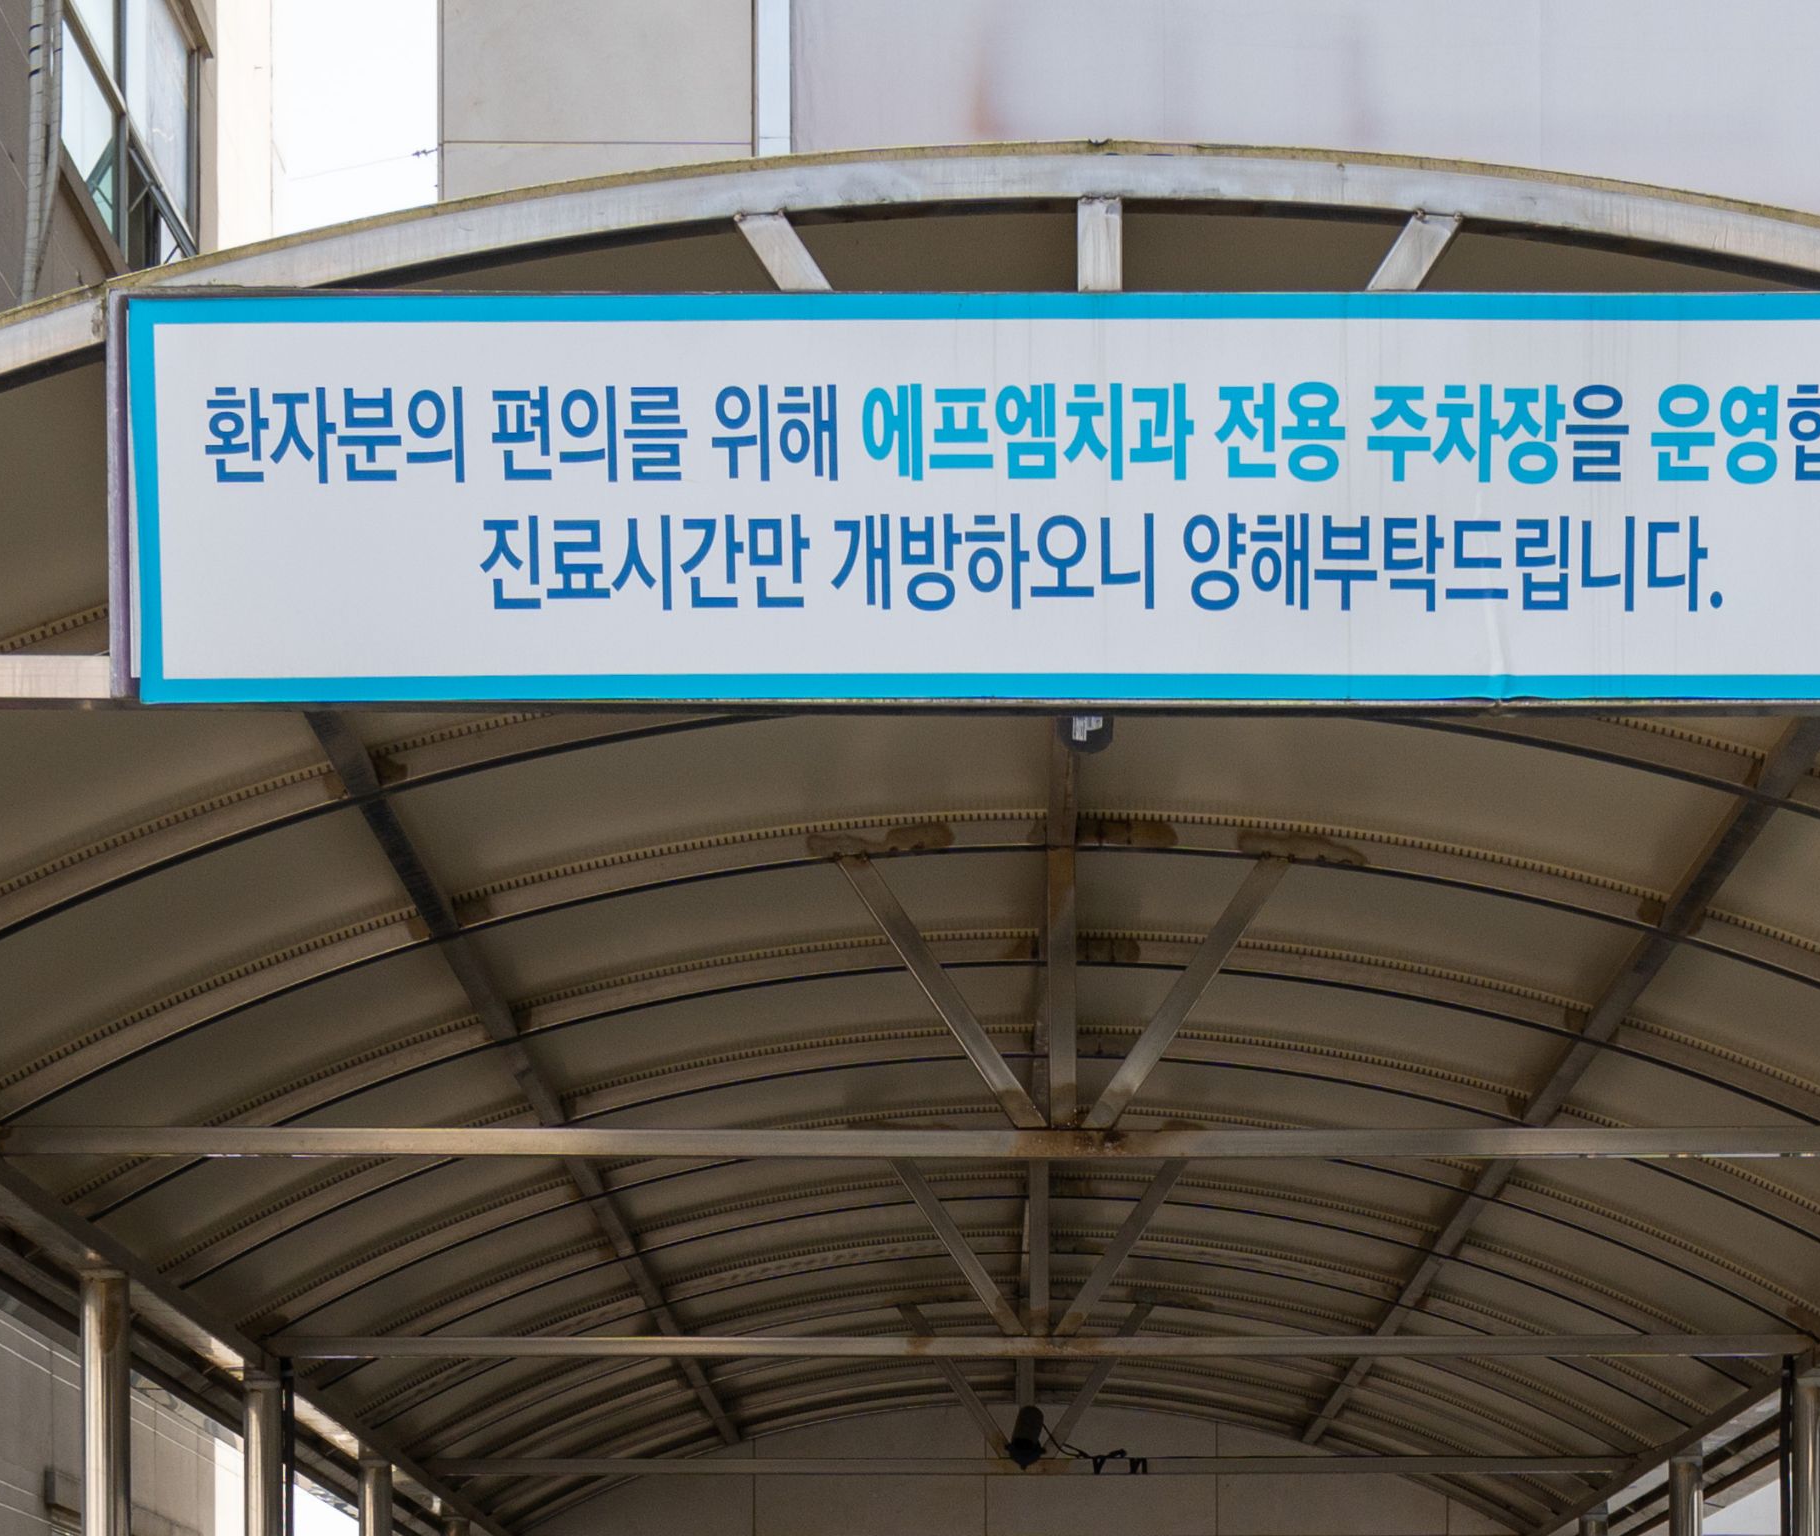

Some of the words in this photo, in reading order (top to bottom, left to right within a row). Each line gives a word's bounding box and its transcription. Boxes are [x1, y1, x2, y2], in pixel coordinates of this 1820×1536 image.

[206, 388, 466, 485] 환자분의
[493, 386, 689, 482] 편의를
[713, 385, 839, 482] 위해
[863, 383, 1196, 482] 에프엠치과
[1216, 382, 1348, 484] 전용
[1367, 385, 1630, 486] 주차장을
[481, 515, 811, 612] 진료시간만
[833, 513, 1155, 613] 개방하오니
[1185, 513, 1724, 614] 양해부탁드립니다.
